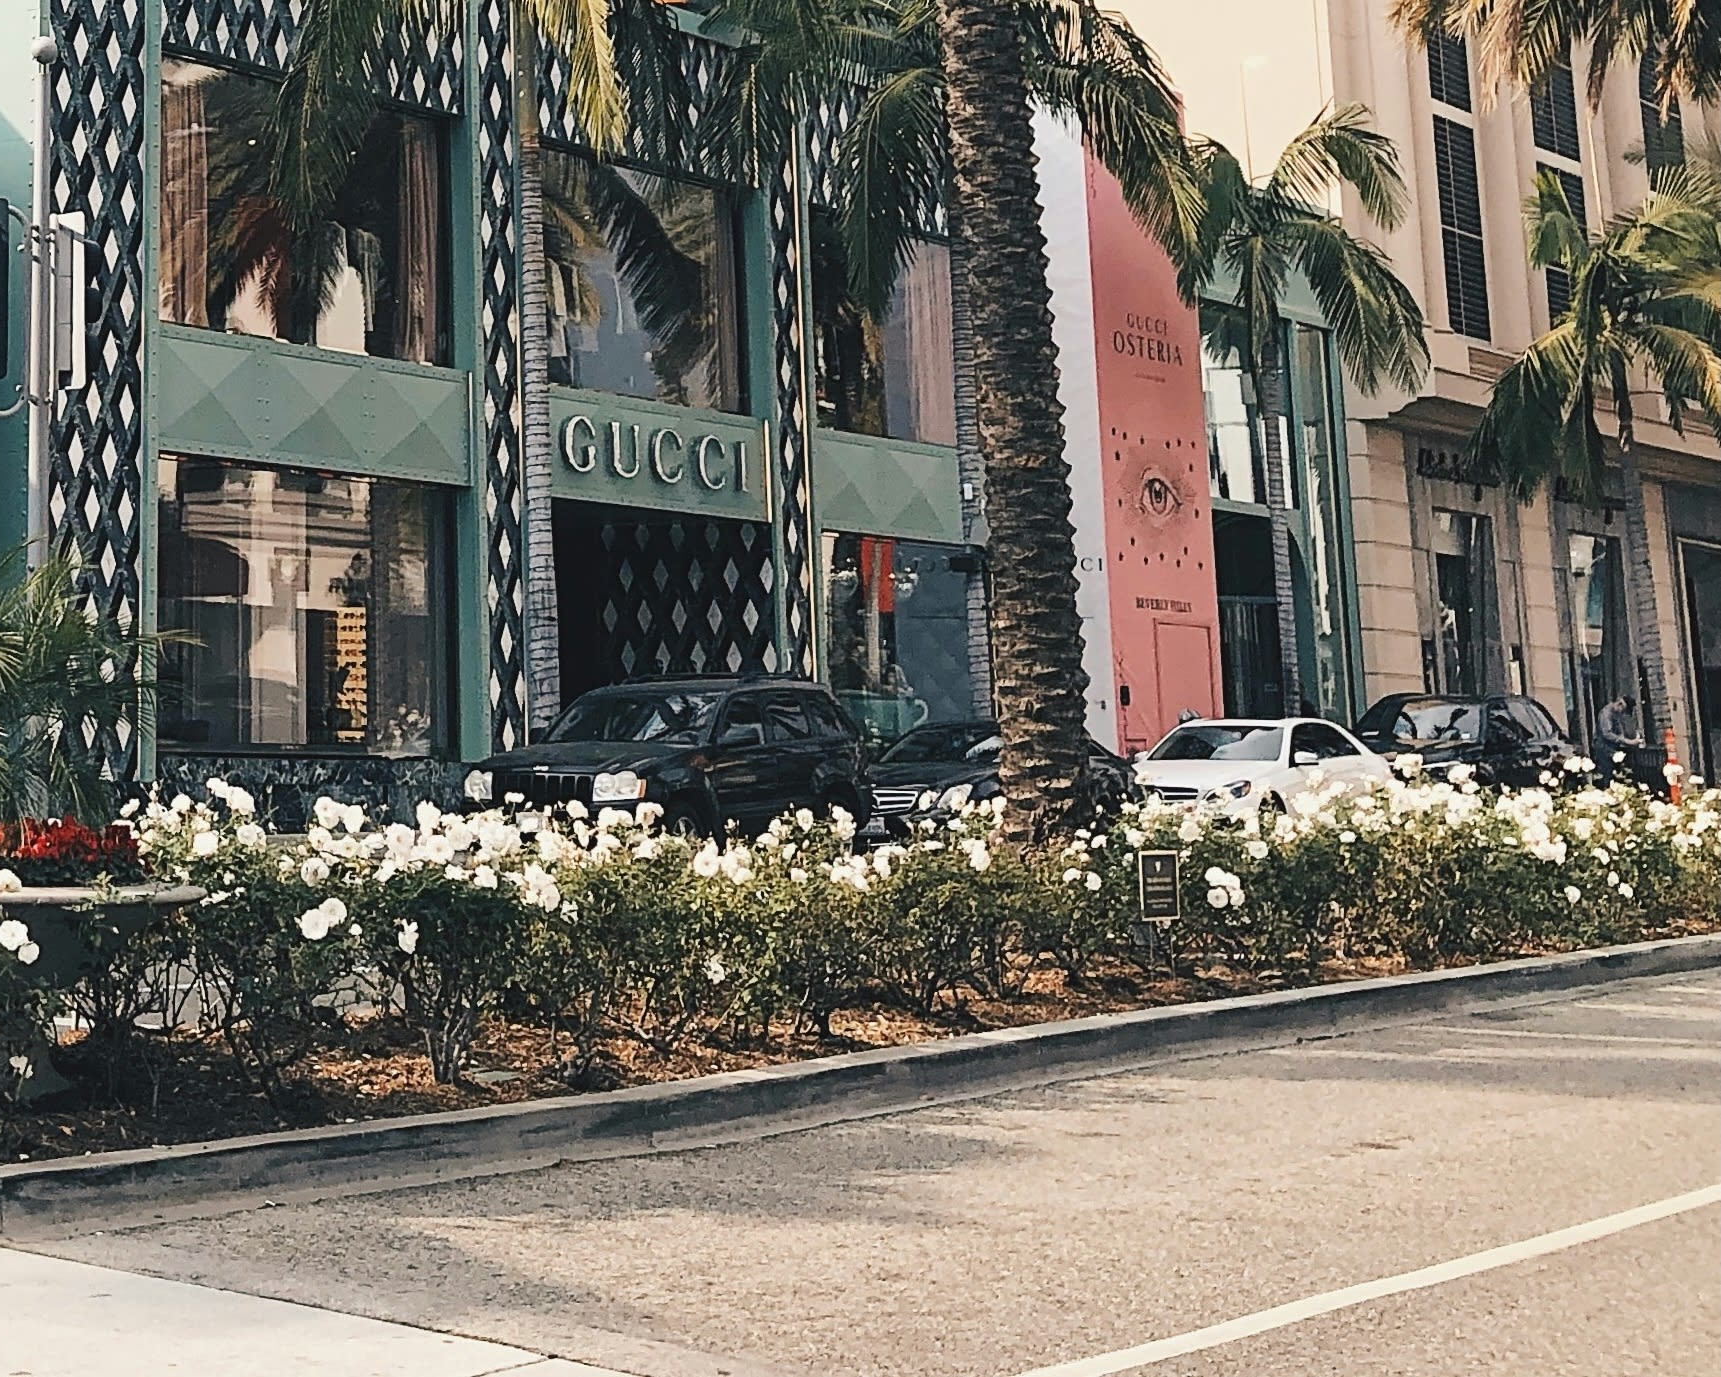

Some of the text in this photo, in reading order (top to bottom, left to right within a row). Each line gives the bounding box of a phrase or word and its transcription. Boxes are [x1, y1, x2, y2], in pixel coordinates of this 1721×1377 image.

[1126, 313, 1168, 337] GUCCI
[1113, 330, 1182, 366] OSTERIA
[562, 415, 749, 492] GUCCI
